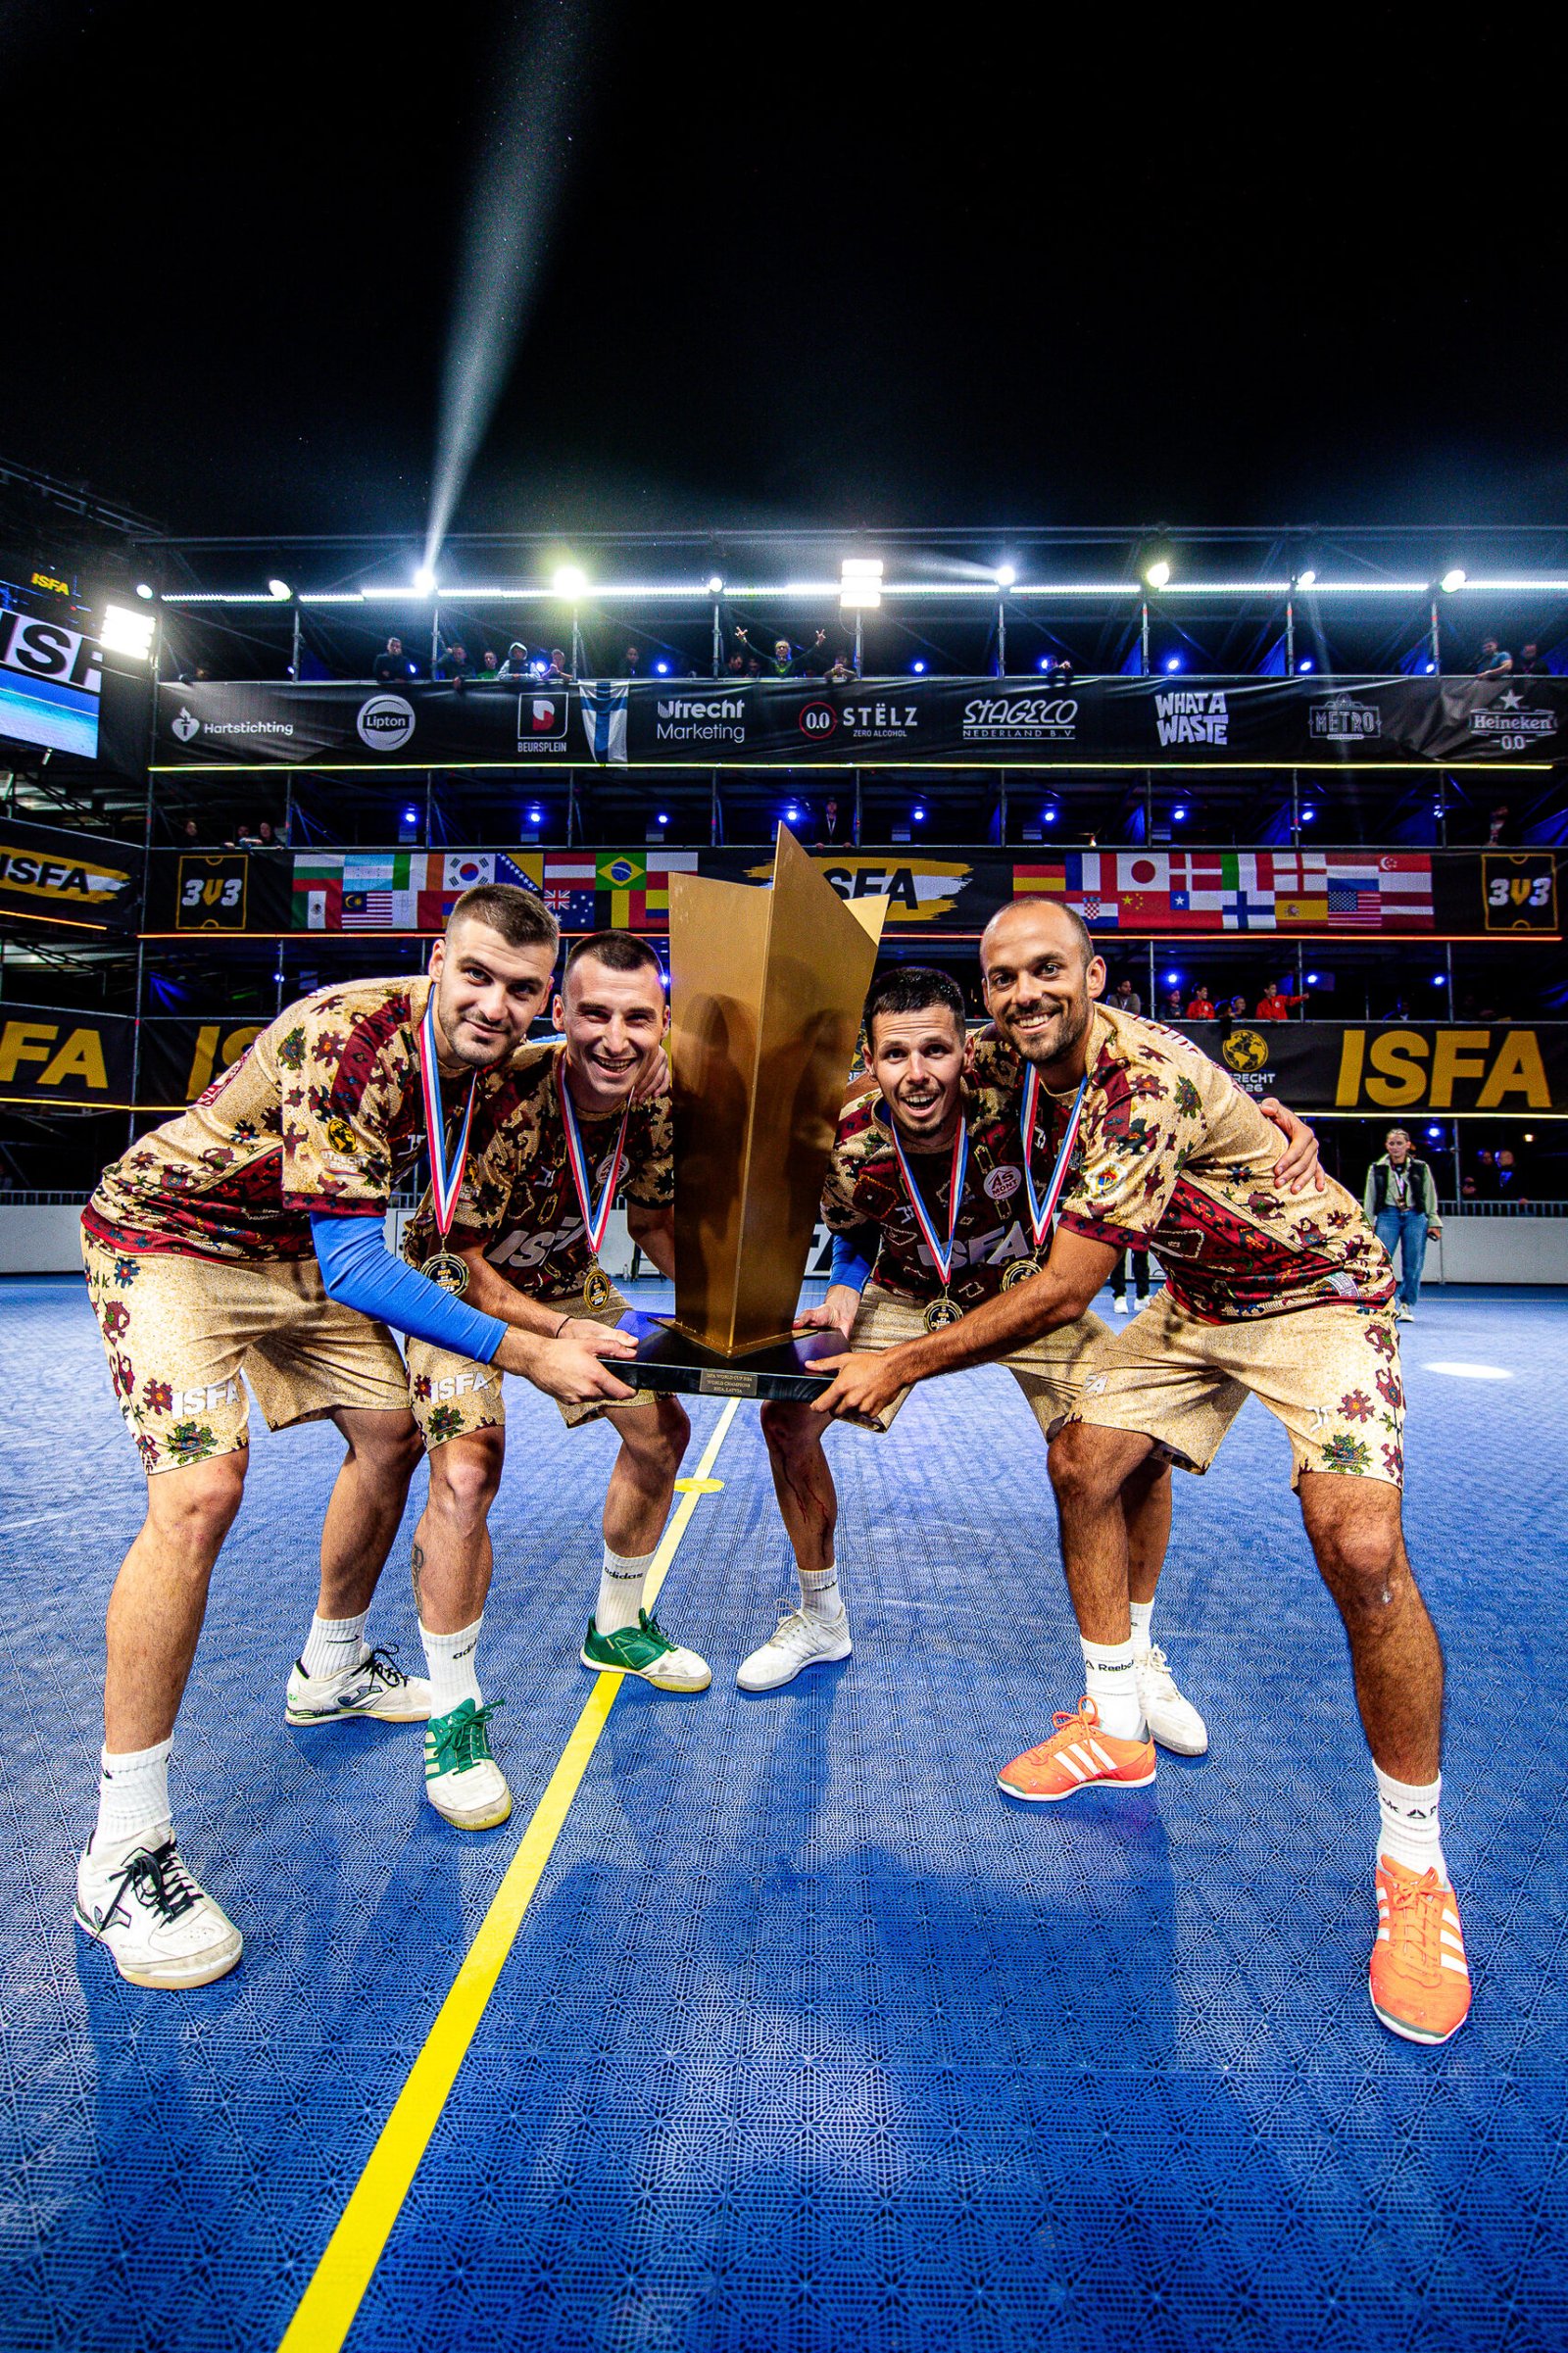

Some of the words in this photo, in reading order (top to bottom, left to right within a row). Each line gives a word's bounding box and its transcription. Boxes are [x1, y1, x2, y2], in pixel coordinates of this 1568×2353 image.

[30, 572, 70, 596] ISFA
[657, 699, 745, 718] Utrecht
[843, 703, 918, 726] STËLZ
[962, 700, 1078, 724] STAGECO
[1154, 692, 1208, 719] WHAT
[1207, 692, 1227, 713] A
[204, 720, 294, 735] Hartstichting
[366, 715, 406, 728] Lipton
[806, 711, 830, 729] 0.0
[1156, 713, 1229, 747] WASTE
[1315, 711, 1375, 734] METRO
[1473, 715, 1553, 730] Heineken
[657, 723, 745, 743] Marketing
[1501, 734, 1526, 750] 0.0
[517, 742, 567, 753] BEURSPLEIN
[0, 853, 90, 895] ISFA
[822, 867, 918, 909] SFA
[1335, 1029, 1552, 1107] ISFA
[431, 1371, 490, 1405] ISFA
[172, 1379, 241, 1421] ISFA
[604, 1566, 644, 1580] adidas
